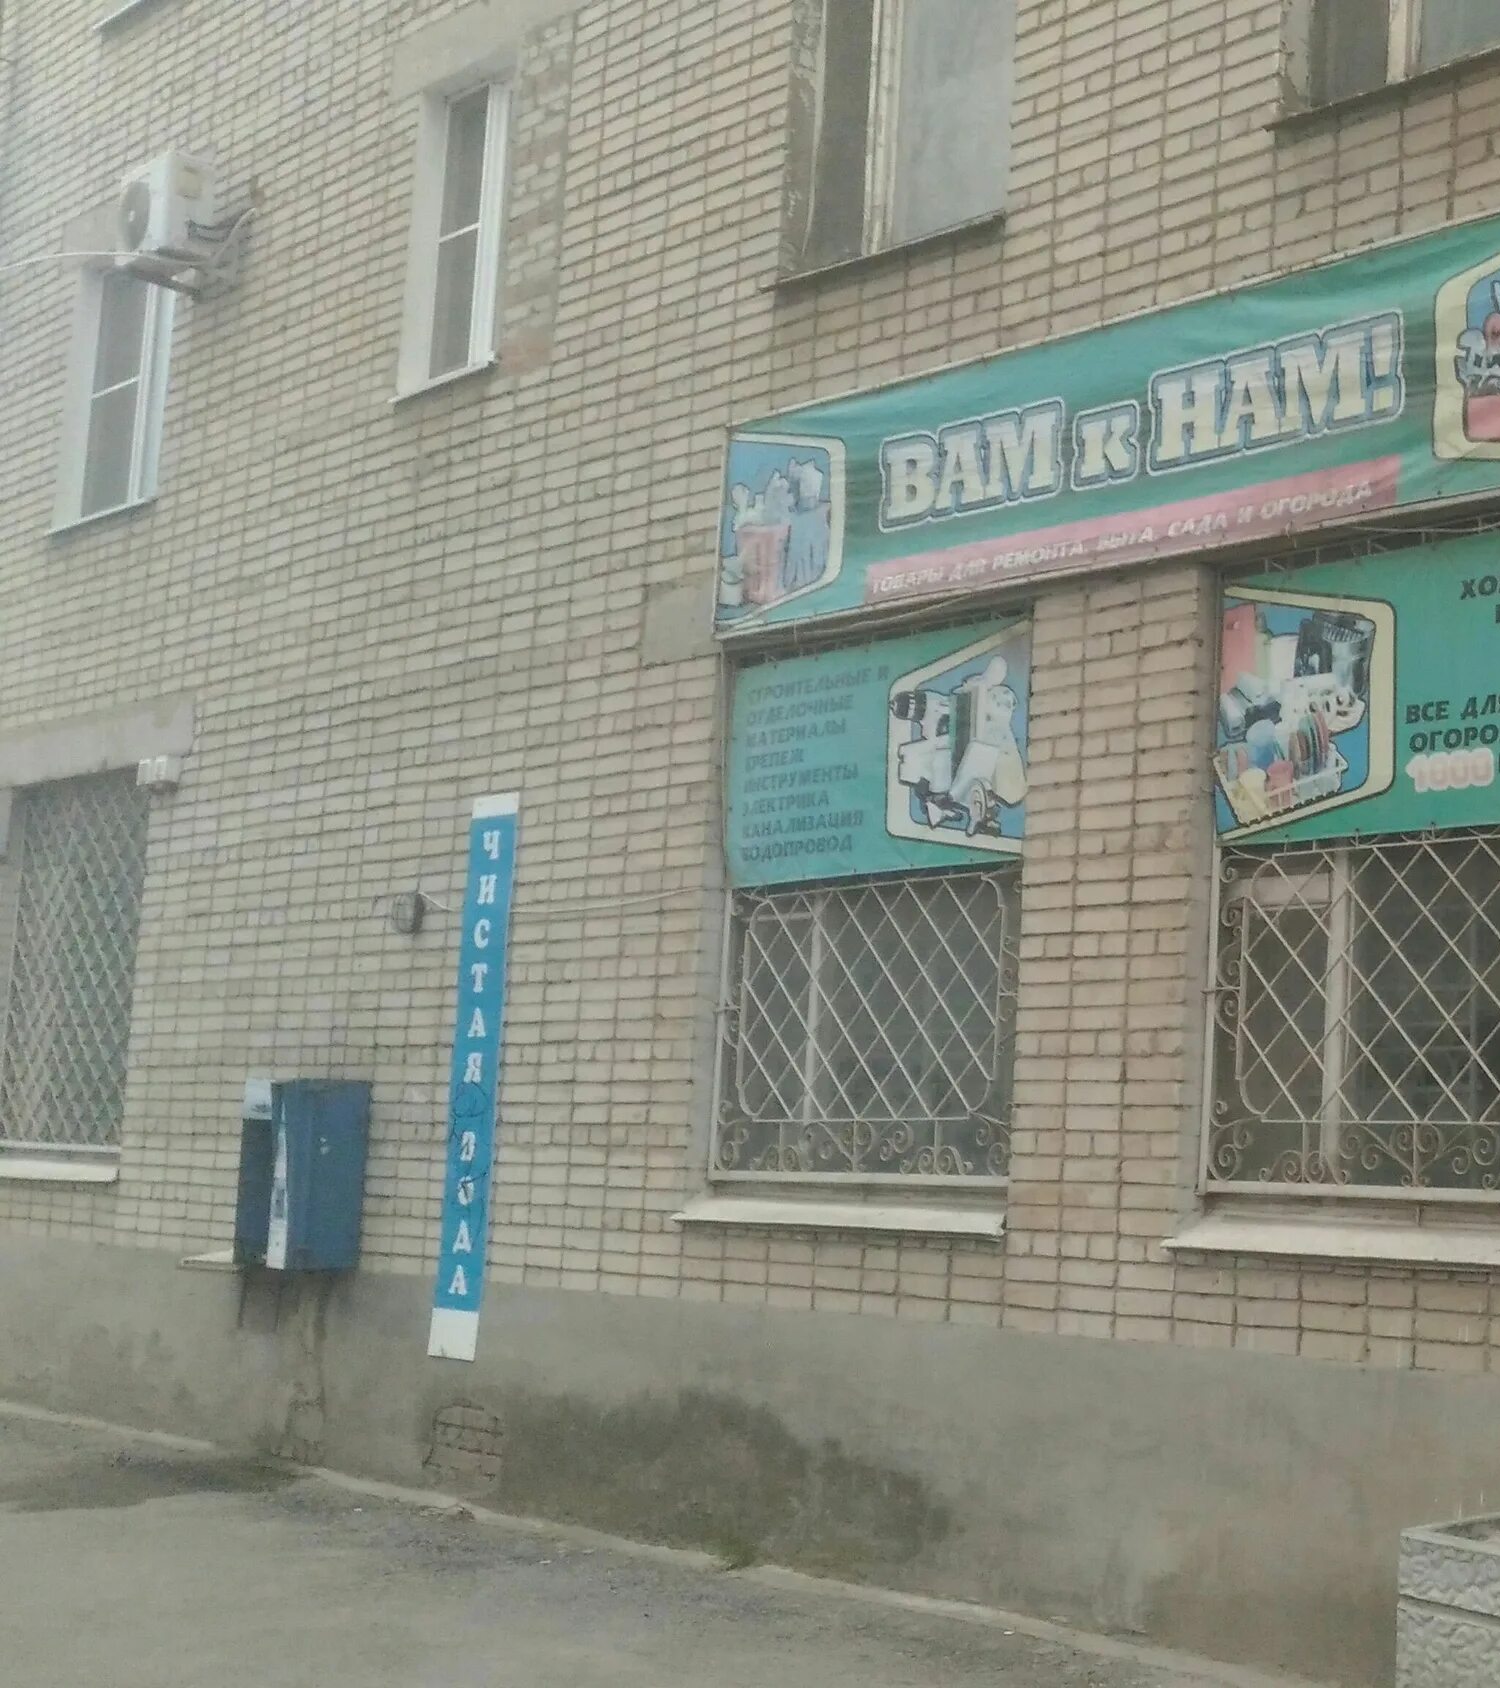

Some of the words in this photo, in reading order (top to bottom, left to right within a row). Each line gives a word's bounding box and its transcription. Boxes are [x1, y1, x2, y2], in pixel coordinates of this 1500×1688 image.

[881, 400, 1063, 530] ВАМ
[1149, 312, 1403, 474] НАМ!
[872, 566, 944, 594] ТОВАРЫ
[949, 558, 988, 582] ДЛЯ
[1168, 511, 1228, 538] САДА
[1237, 504, 1256, 524] И
[1406, 699, 1449, 725] ВСЕ
[1408, 750, 1493, 790] 1000
[742, 834, 853, 863] ВОДОПРОВОД
[461, 829, 501, 1085] ЧИСТАЯ
